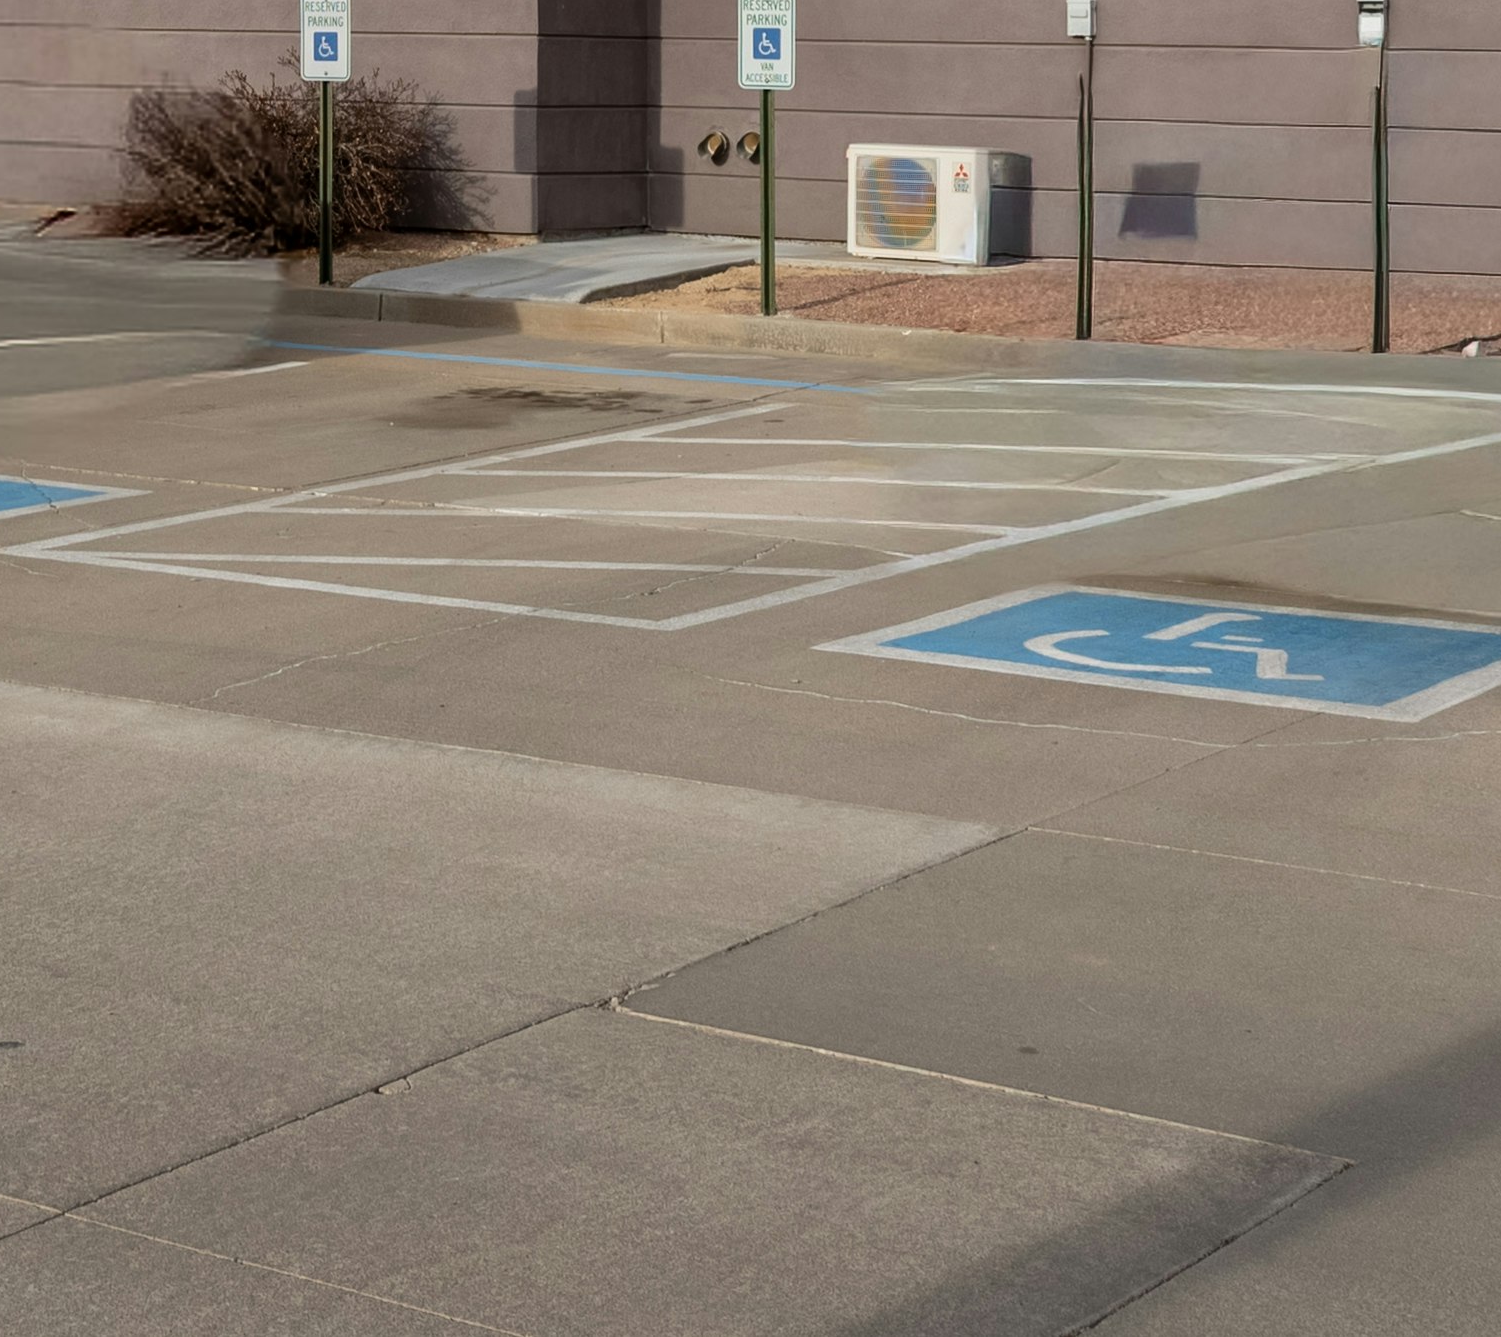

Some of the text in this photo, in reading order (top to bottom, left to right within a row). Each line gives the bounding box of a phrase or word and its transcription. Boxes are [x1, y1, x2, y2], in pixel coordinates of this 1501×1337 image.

[305, 1, 346, 12] RESERVED
[743, 0, 790, 11] RESERVED
[308, 16, 344, 27] PARKING
[746, 14, 787, 26] PARKING
[760, 63, 774, 71] VAN
[745, 73, 788, 83] ACCESSIBLE
